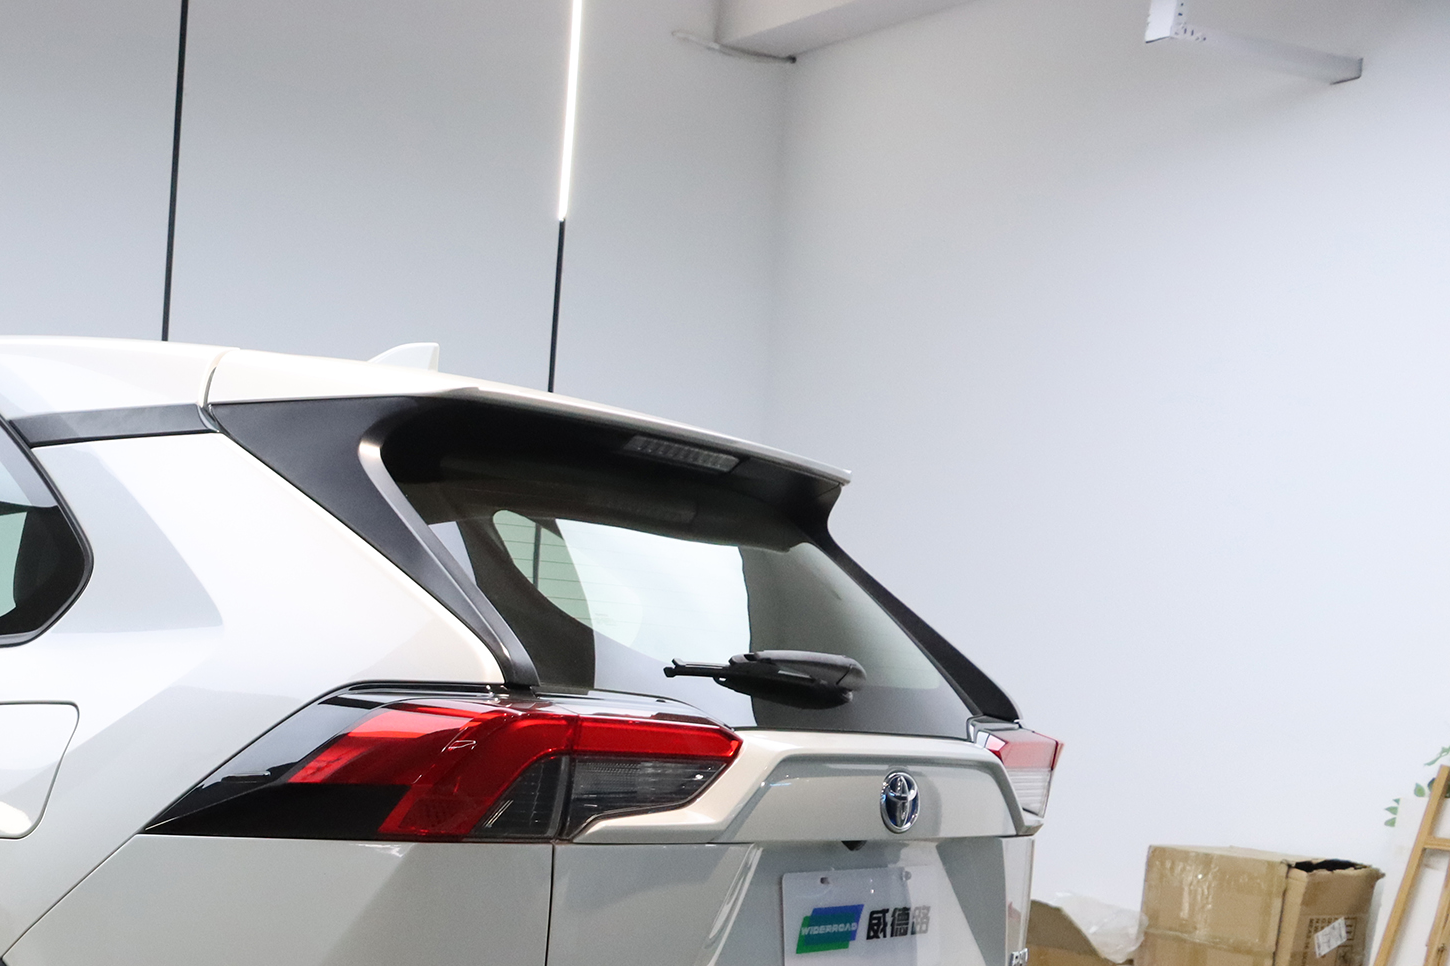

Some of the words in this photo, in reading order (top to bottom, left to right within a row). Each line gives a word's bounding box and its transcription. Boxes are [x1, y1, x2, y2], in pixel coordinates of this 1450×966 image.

[801, 922, 857, 935] WIDERROAD
[866, 905, 931, 940] 威德路
